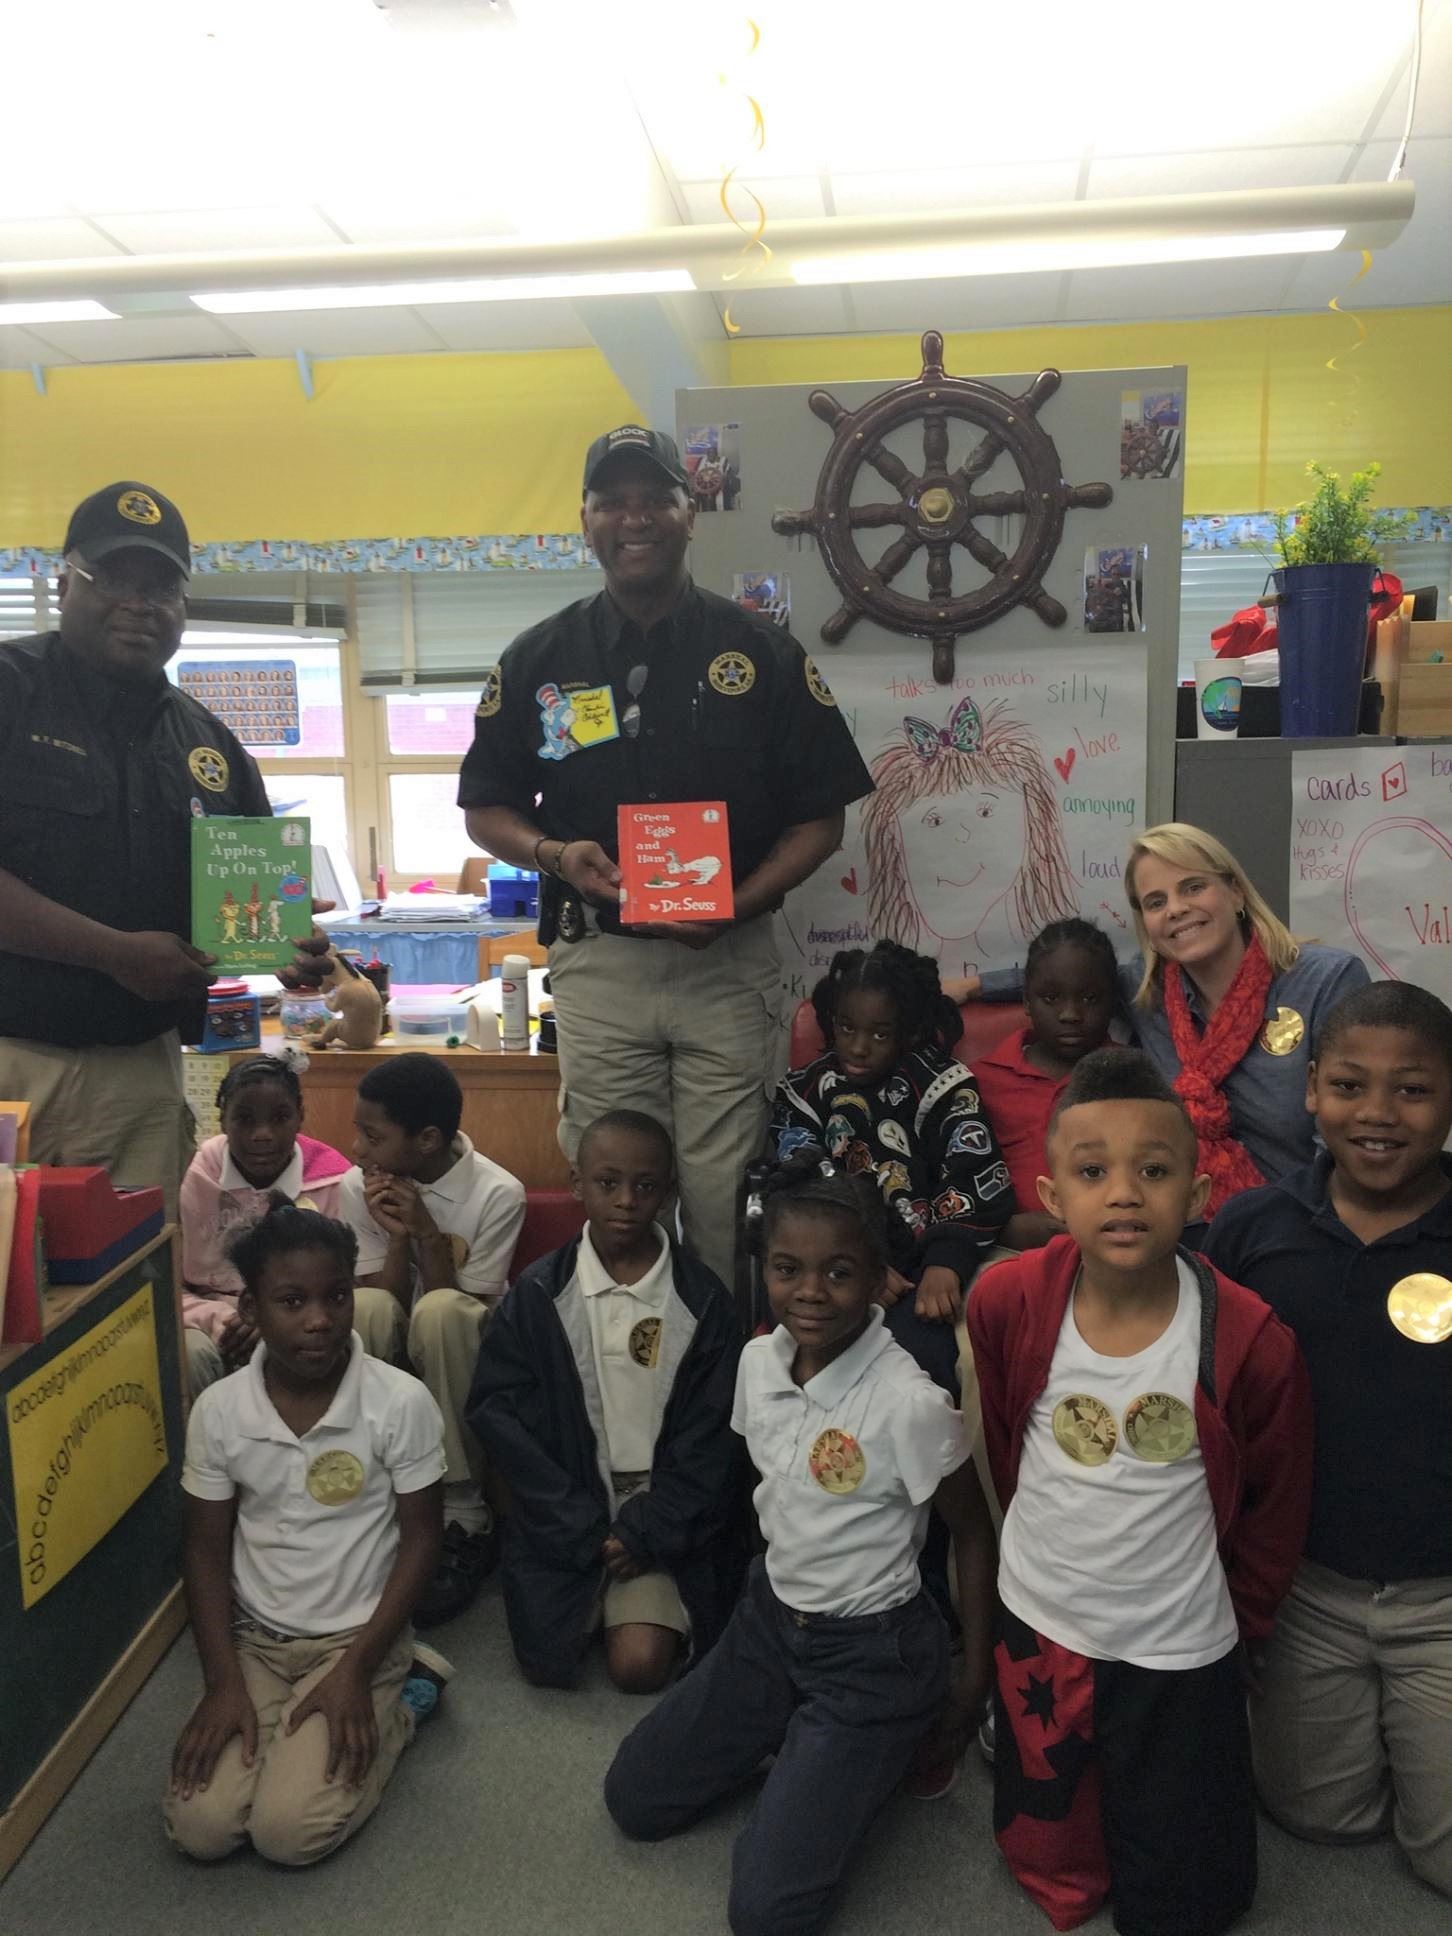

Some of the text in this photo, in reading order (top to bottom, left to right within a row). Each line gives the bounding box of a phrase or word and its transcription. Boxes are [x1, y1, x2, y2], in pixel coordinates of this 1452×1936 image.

[608, 427, 650, 440] GLOCK
[886, 676, 937, 699] talks
[983, 668, 1034, 689] much
[1047, 673, 1108, 719] silly
[1073, 727, 1121, 761] love
[633, 813, 671, 822] Green
[1062, 796, 1136, 826] annoying
[205, 826, 238, 840] Ten
[644, 825, 677, 838] Eggs
[1296, 818, 1345, 840] XOXO
[210, 844, 268, 860] Apples
[635, 841, 660, 850] and
[637, 854, 666, 864] Ham
[1081, 850, 1122, 880] loud
[207, 860, 297, 878] Up On Top!
[660, 899, 682, 913] Dr.
[682, 897, 718, 912] Seuss
